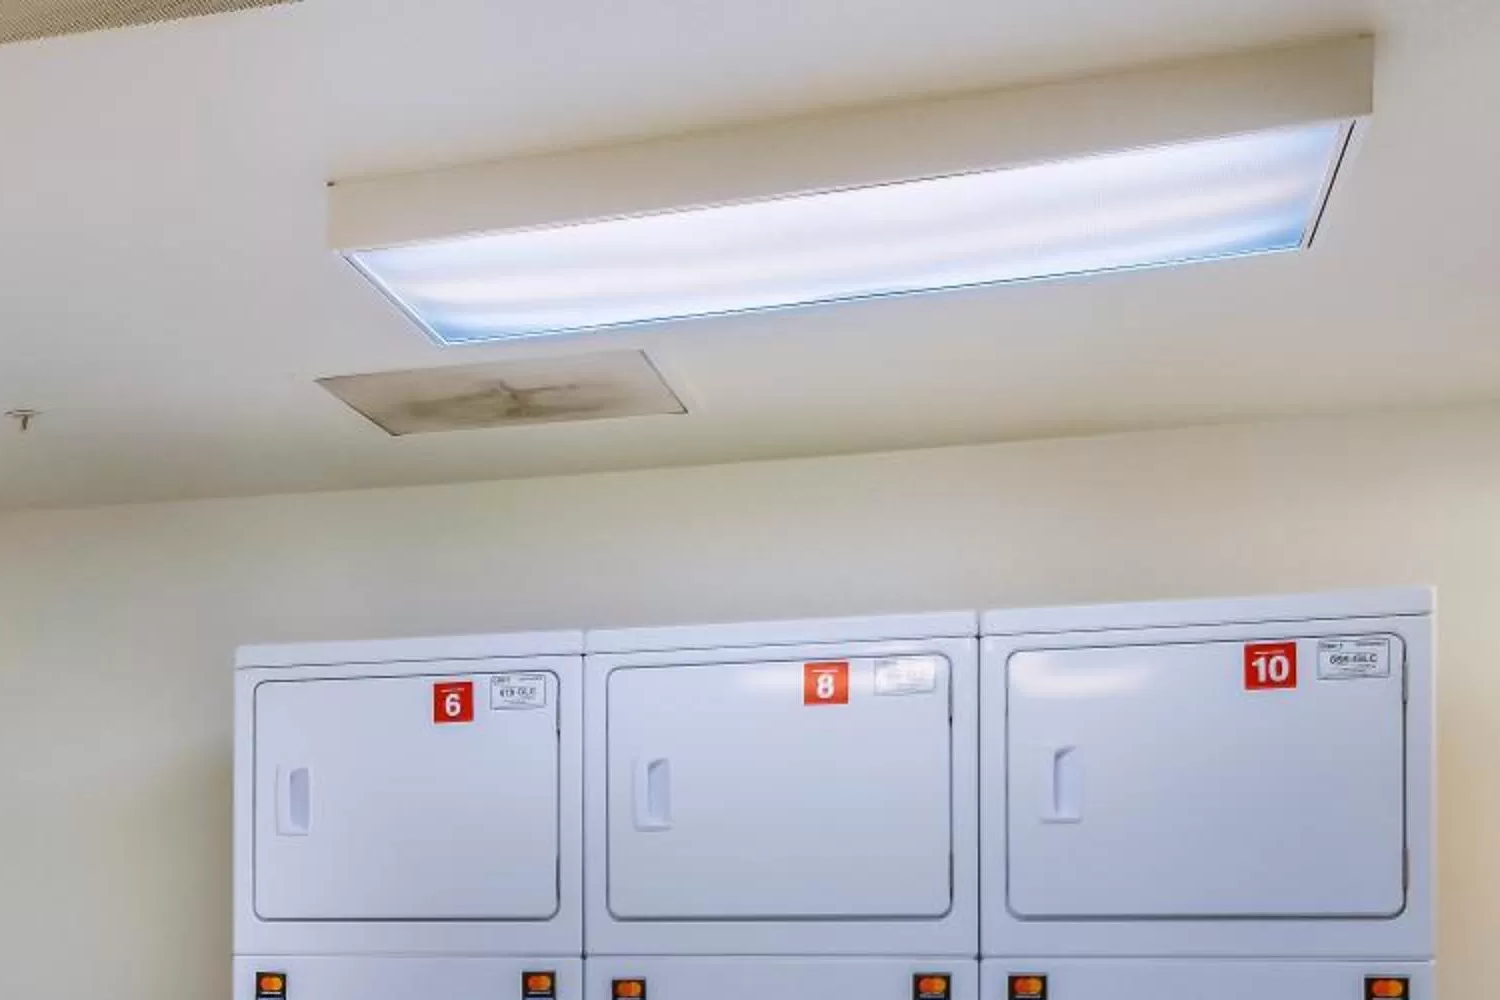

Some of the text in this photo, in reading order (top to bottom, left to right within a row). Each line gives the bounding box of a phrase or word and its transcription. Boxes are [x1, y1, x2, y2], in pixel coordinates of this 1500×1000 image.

[1252, 655, 1290, 683] 10
[816, 673, 835, 699] 8
[445, 693, 461, 717] 6
